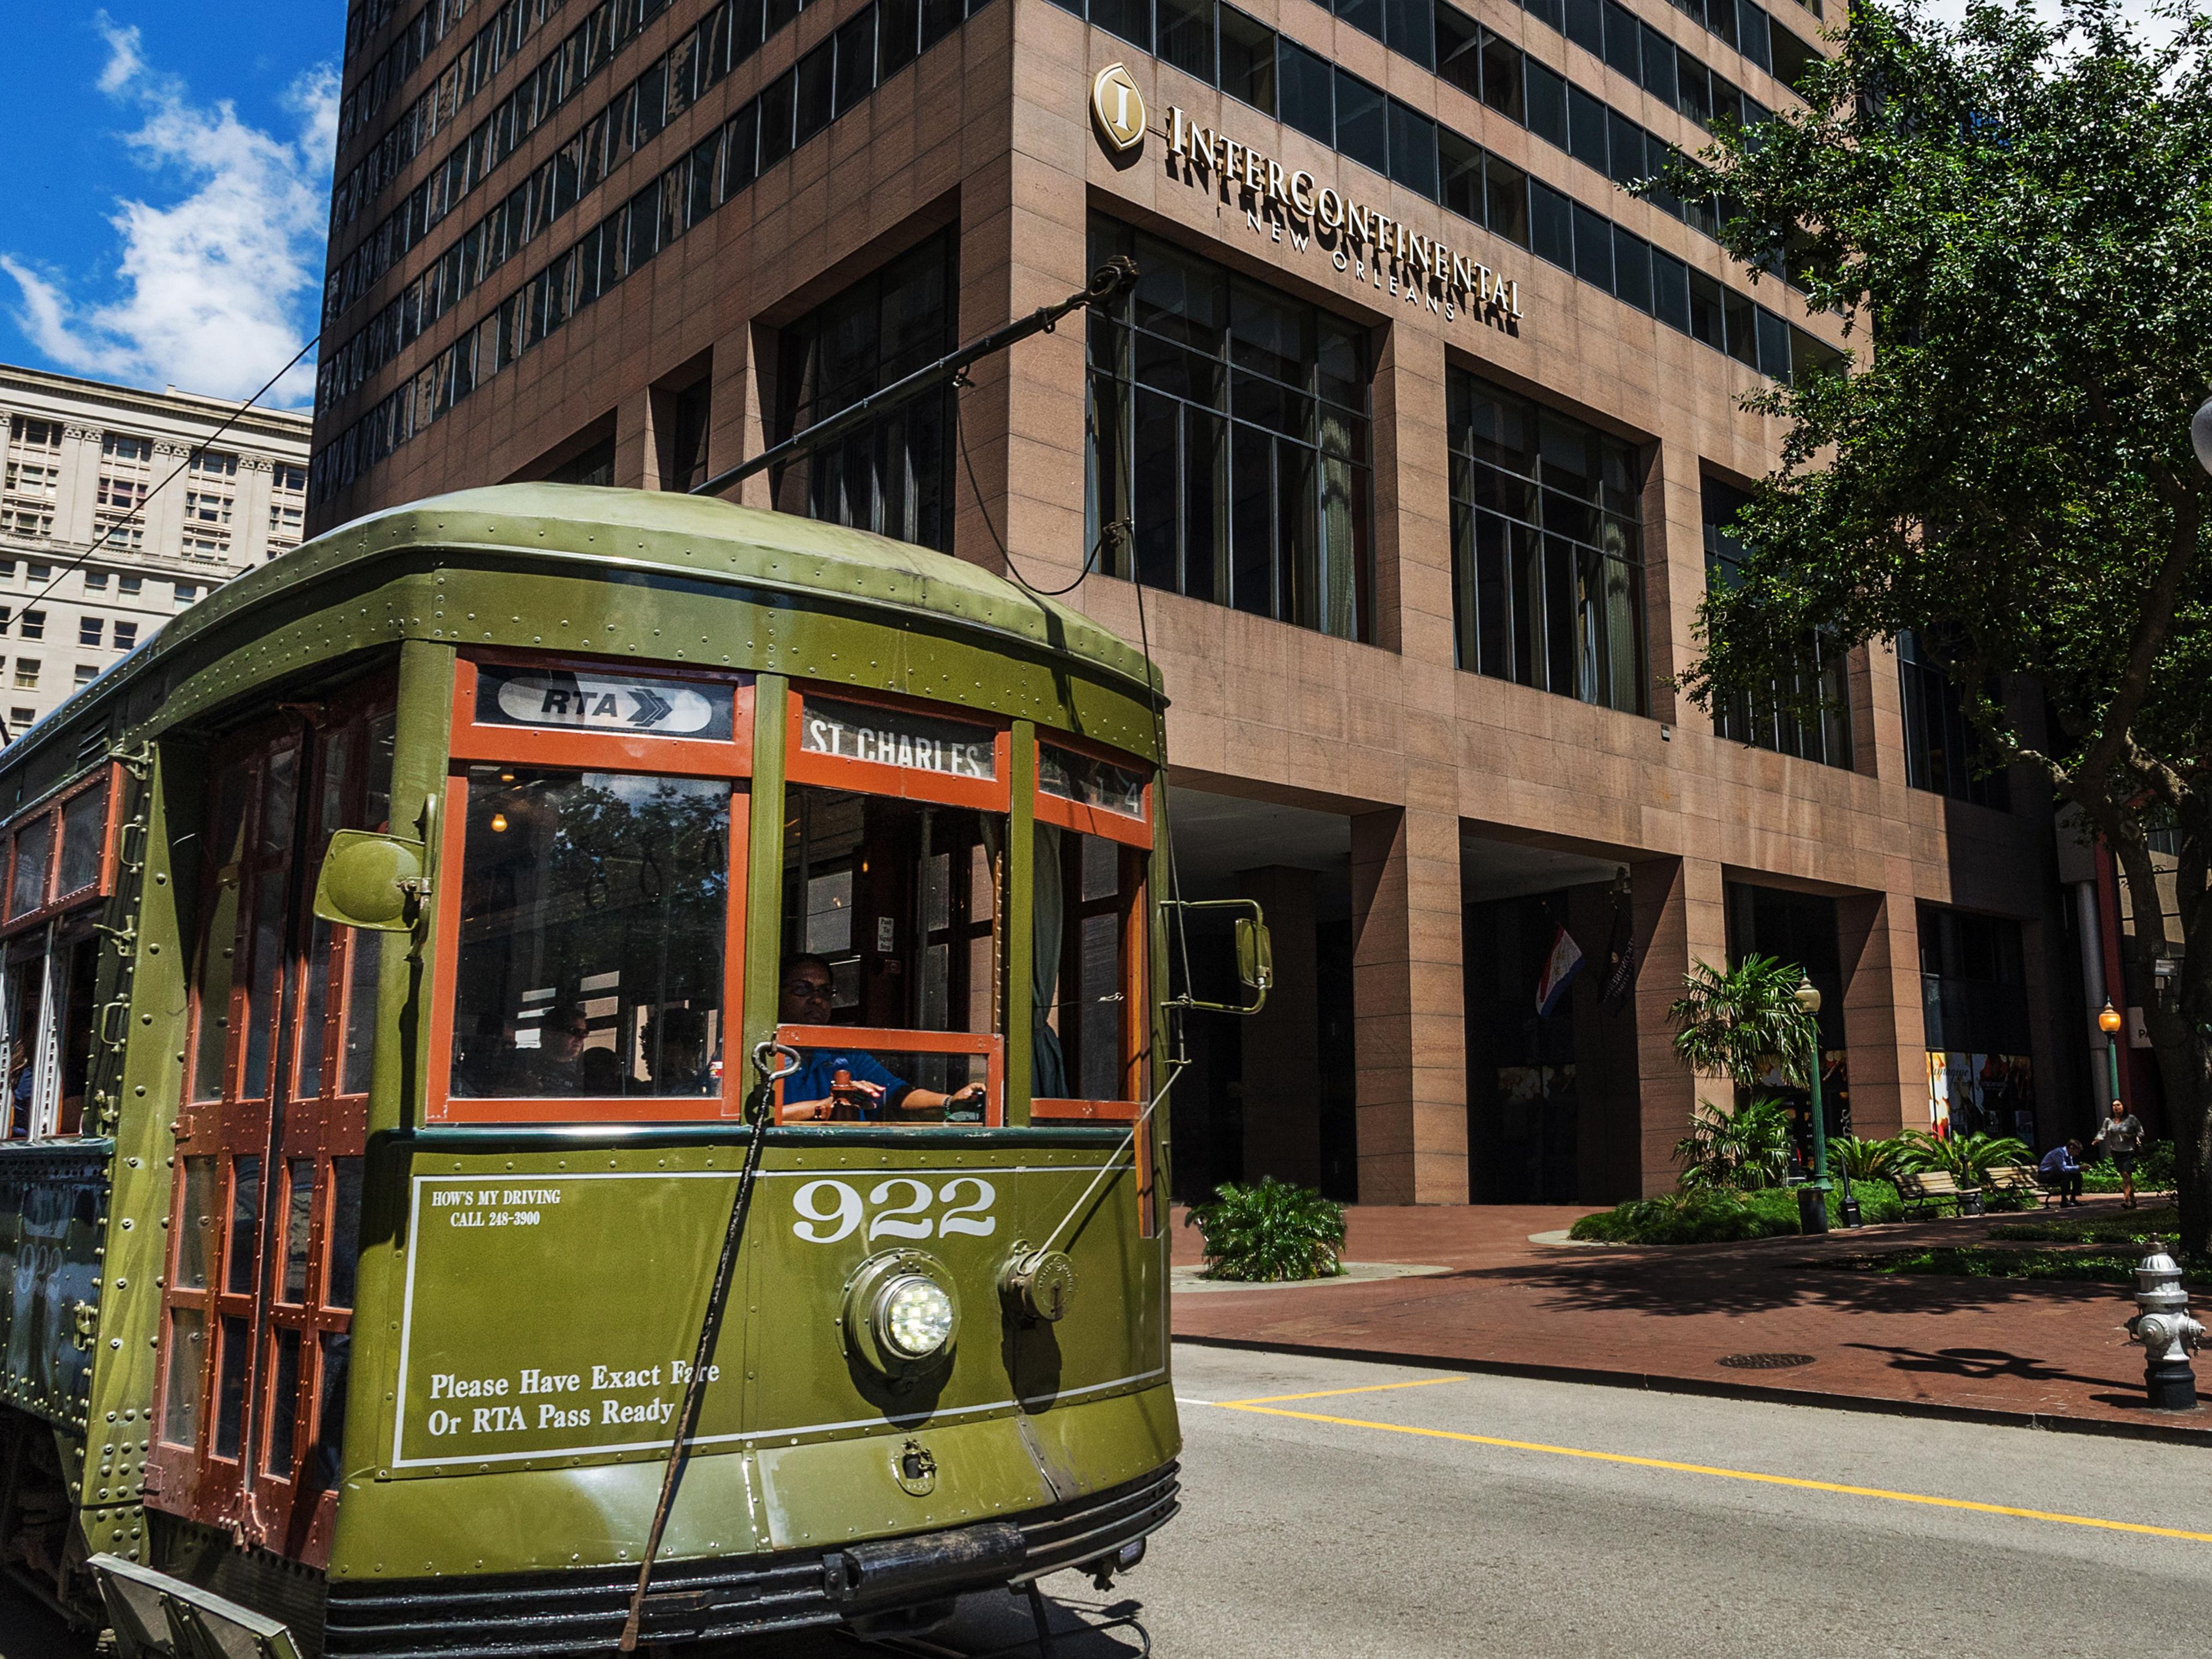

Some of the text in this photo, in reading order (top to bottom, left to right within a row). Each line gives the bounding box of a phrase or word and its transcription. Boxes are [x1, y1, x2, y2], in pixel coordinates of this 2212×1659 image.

[1167, 105, 1524, 319] INTERCONTINENTAL
[1247, 208, 1454, 322] NEW ORLEANS
[541, 688, 618, 717] RTA
[810, 719, 981, 776] ST CHARLES
[431, 1190, 561, 1206] HOW'S MY DRIVING
[792, 1177, 995, 1244] 922
[450, 1211, 540, 1227] CALL 248-3900
[430, 1360, 720, 1399] Please Have Exact Fare
[428, 1398, 674, 1436] Or RTA Pass Ready
